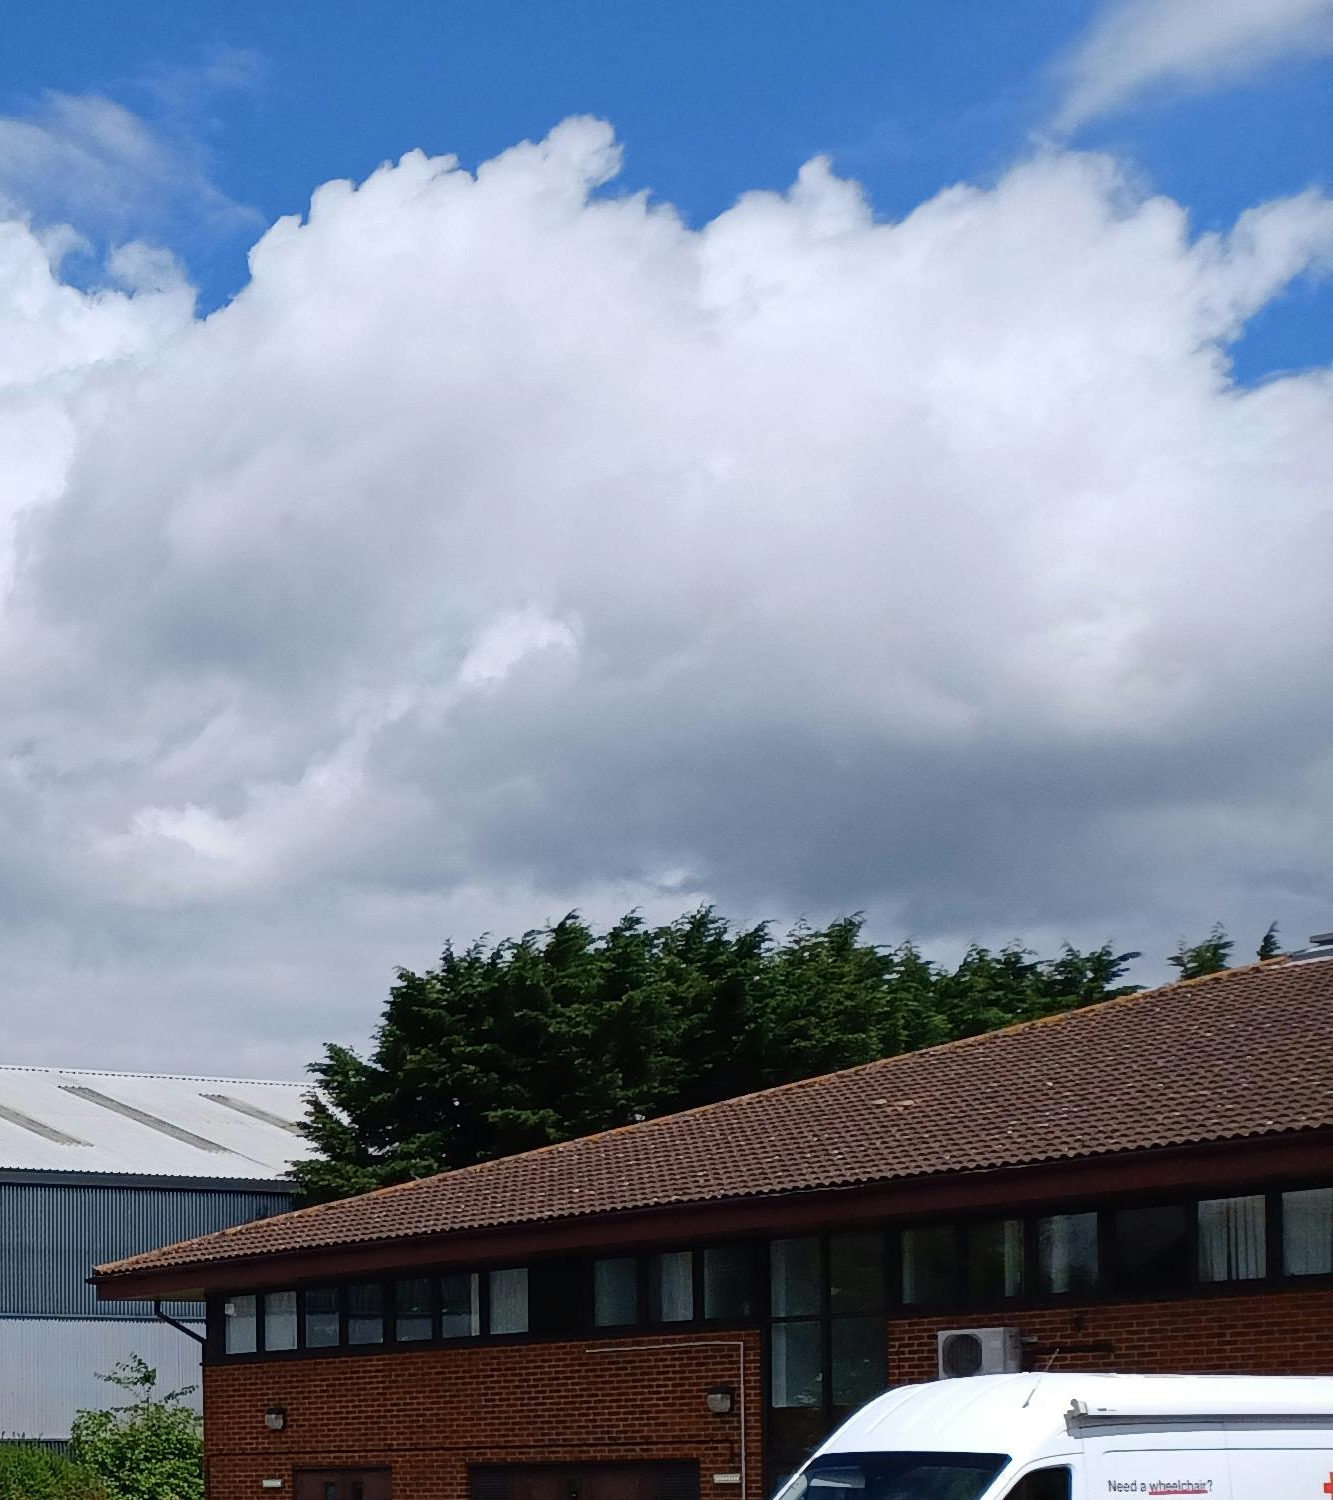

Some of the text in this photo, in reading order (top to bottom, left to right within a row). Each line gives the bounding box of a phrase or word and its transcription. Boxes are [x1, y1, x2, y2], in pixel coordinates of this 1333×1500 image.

[1108, 1480, 1213, 1492] Need a wheelchair?
